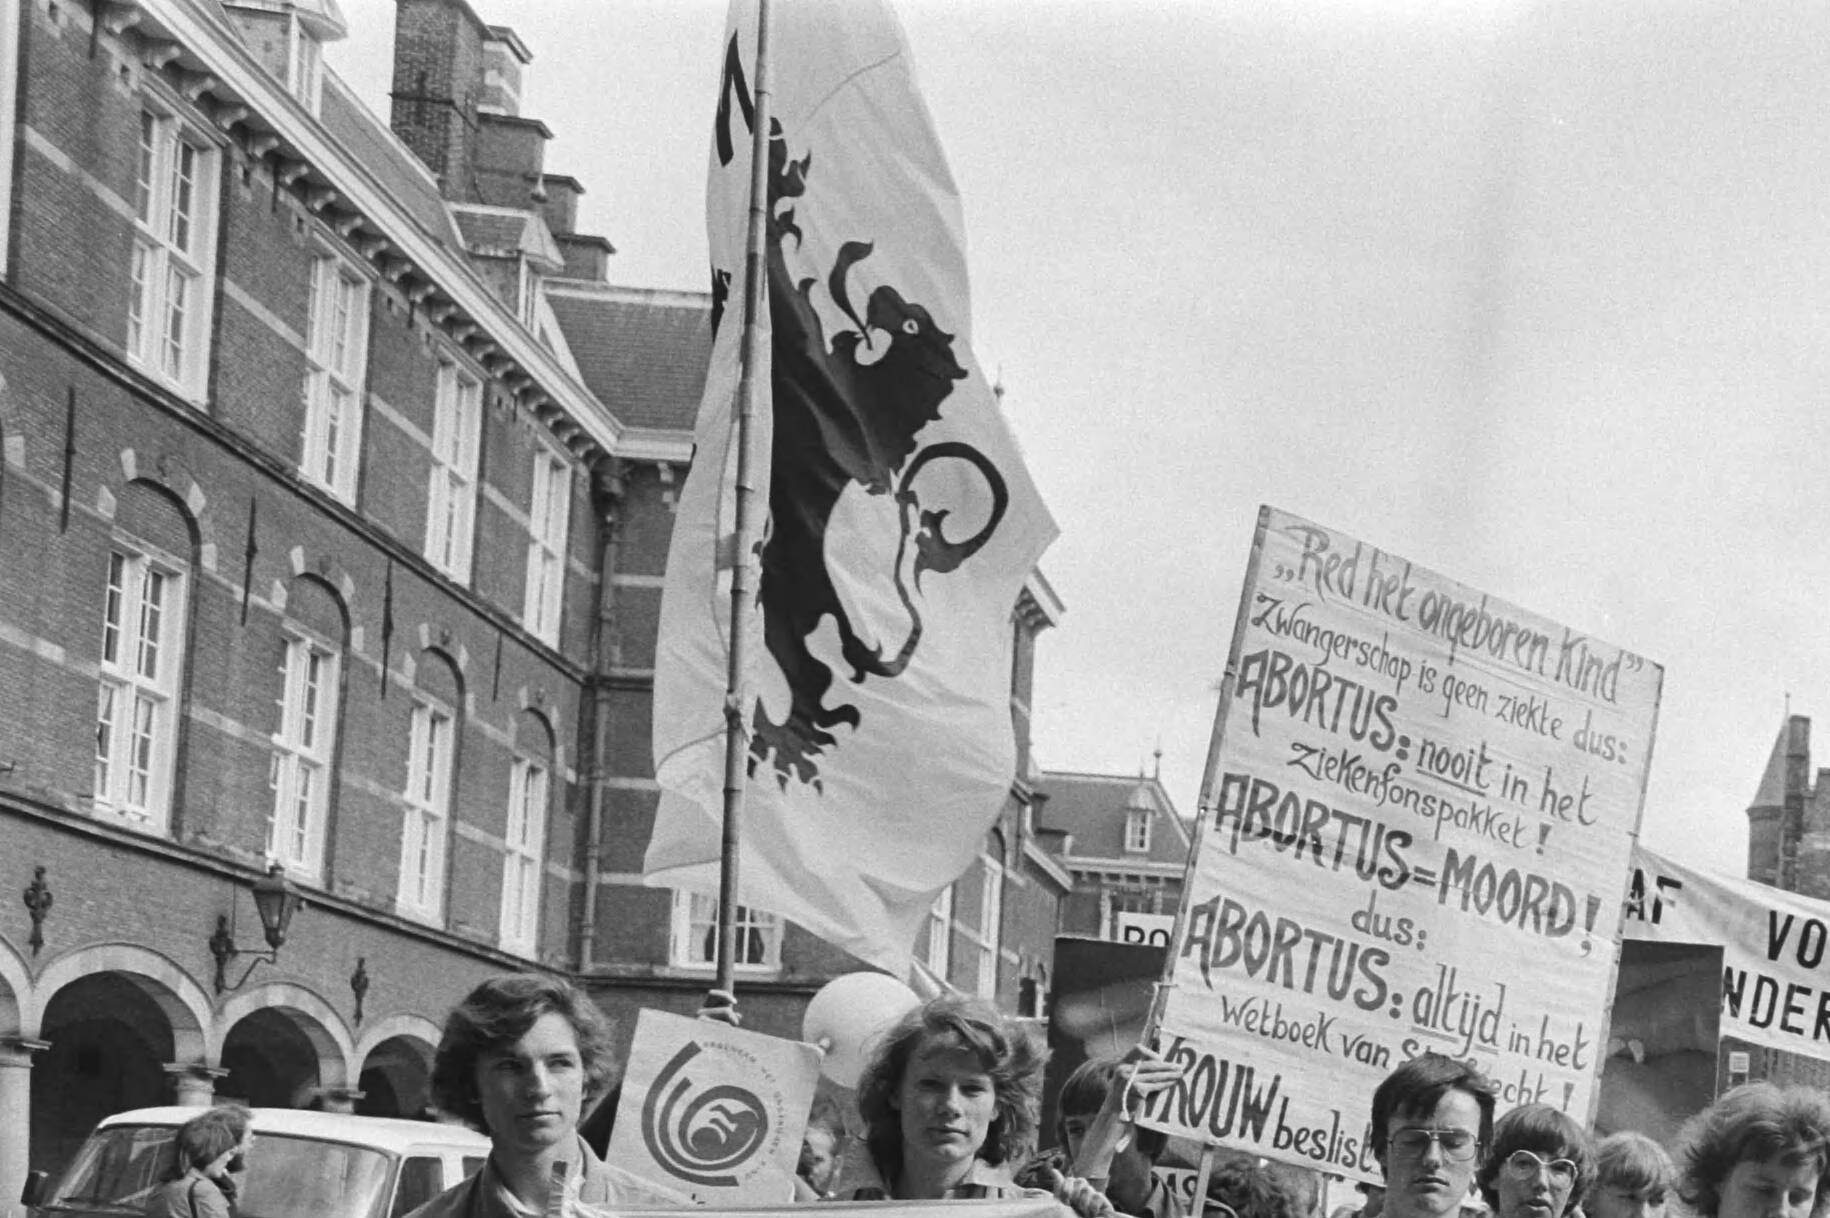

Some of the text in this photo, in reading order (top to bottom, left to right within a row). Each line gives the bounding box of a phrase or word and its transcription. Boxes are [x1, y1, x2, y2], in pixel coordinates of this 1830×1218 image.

[1252, 591, 1629, 764] Zwangerschap is geen ziekte dus:
[1363, 546, 1415, 621] het
[1418, 593, 1549, 672] ongeboren
[1235, 649, 1598, 826] ABORTUS: nooit in het
[1180, 895, 1403, 1020] ABORTUS:
[1411, 961, 1506, 1059] altijd
[1507, 1022, 1531, 1057] in
[1536, 1013, 1591, 1071] het
[1350, 888, 1428, 952] dus:
[1340, 1033, 1391, 1070] van
